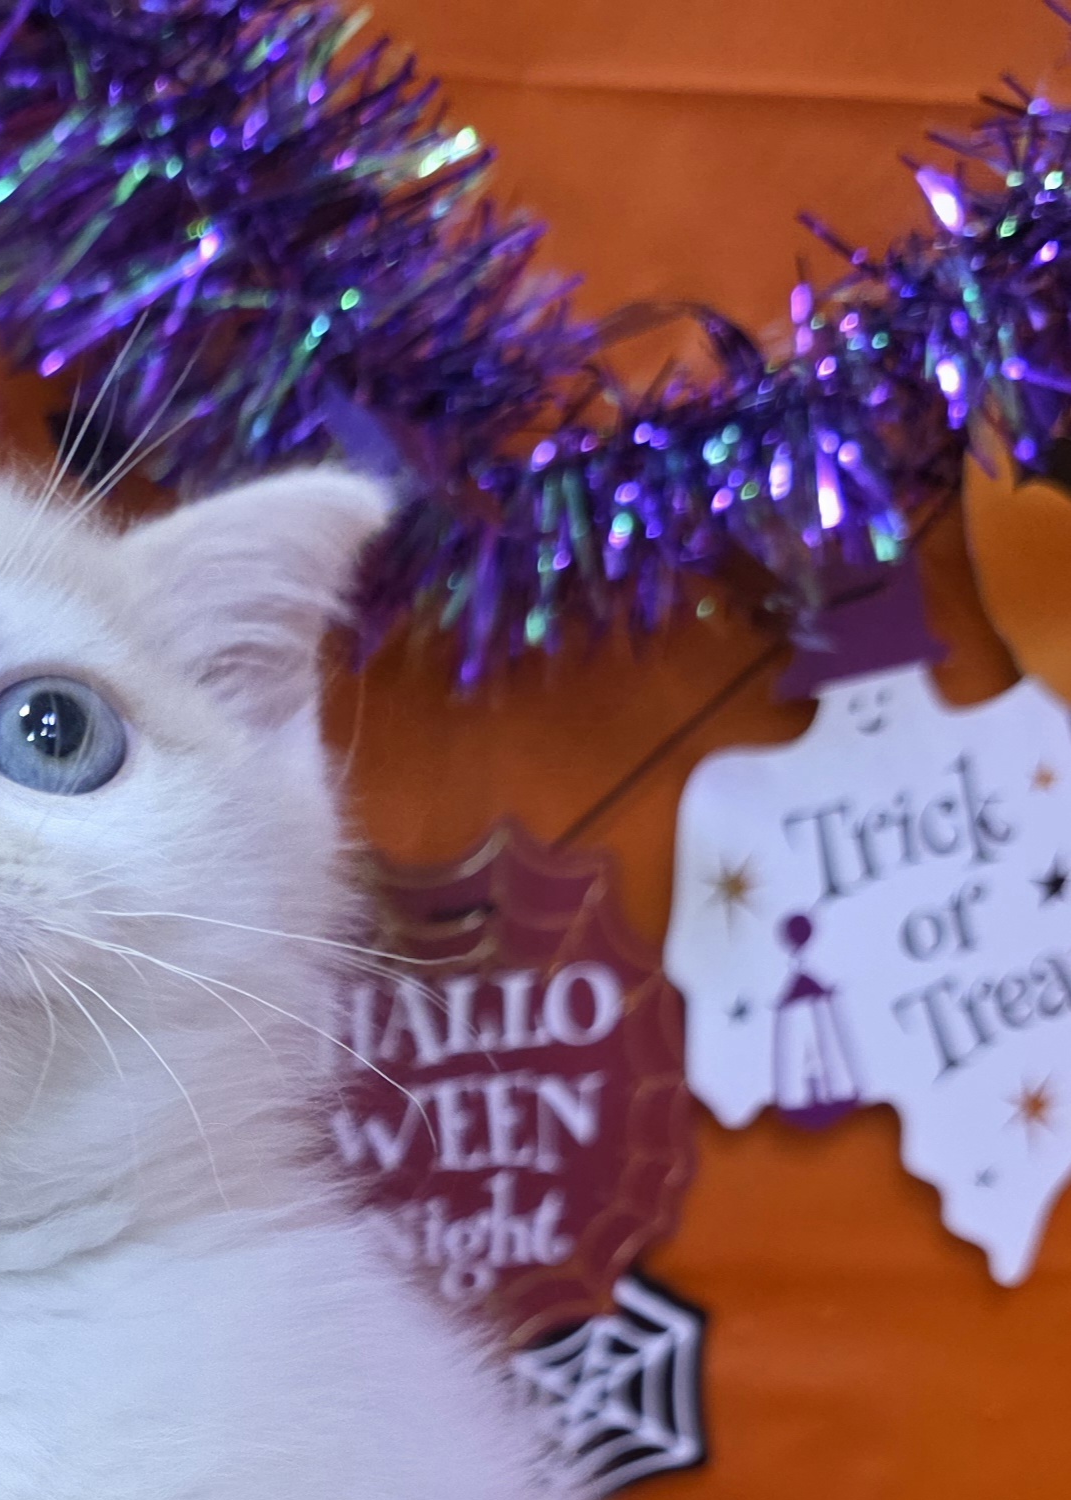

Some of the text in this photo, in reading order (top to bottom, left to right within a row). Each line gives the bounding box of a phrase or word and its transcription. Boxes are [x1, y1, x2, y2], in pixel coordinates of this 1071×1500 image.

[781, 751, 1014, 897] Trick
[898, 880, 989, 962] or
[395, 1170, 576, 1301] ight
